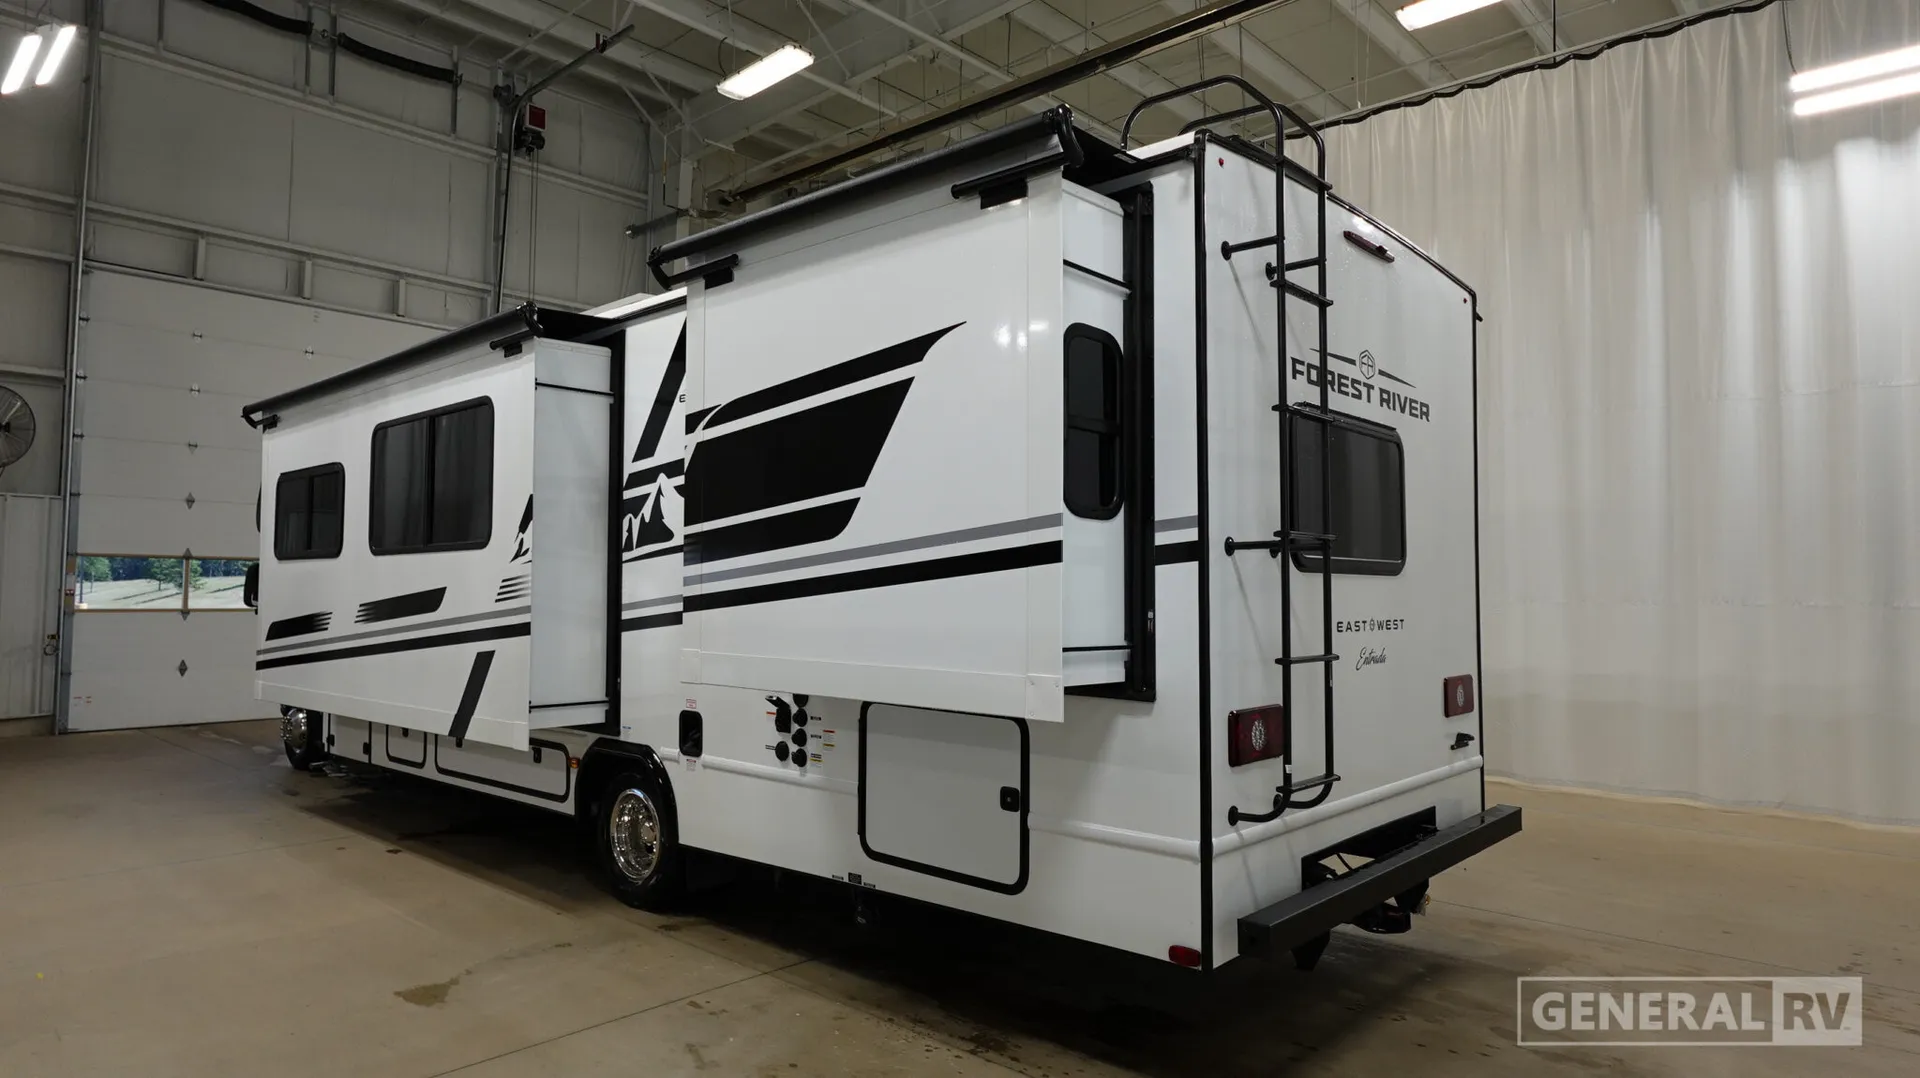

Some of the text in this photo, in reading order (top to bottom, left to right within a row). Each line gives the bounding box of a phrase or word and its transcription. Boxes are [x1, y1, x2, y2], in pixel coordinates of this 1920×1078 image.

[1290, 356, 1430, 422] FOREST RIVER
[1336, 619, 1405, 633] EAST WEST
[1355, 646, 1387, 671] Entrada
